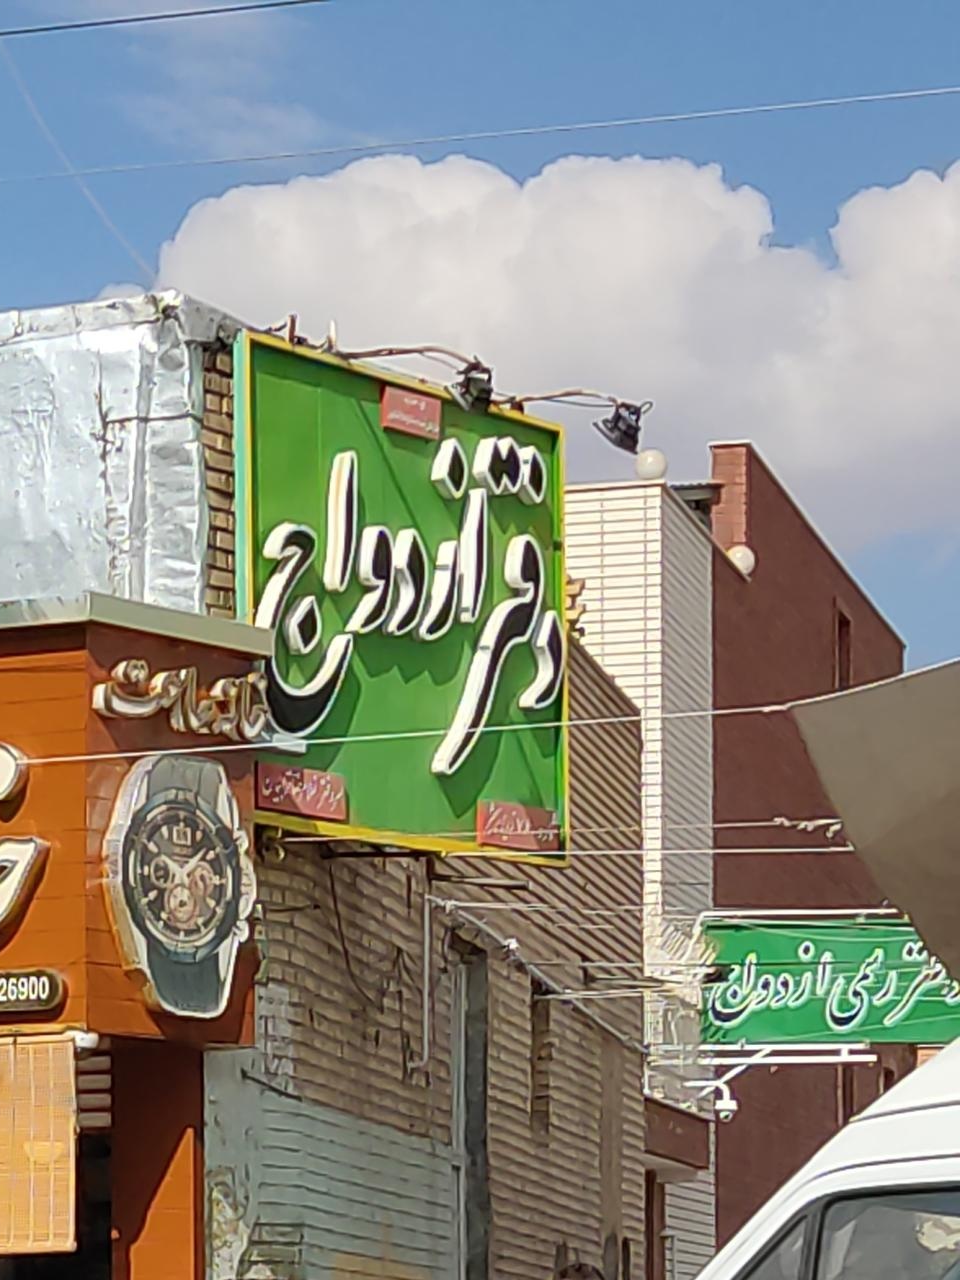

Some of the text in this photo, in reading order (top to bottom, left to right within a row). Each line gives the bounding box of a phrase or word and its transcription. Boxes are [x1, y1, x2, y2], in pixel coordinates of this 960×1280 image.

[254, 436, 565, 775] دفتر ازدواج
[91, 659, 222, 735] ساعت
[708, 940, 837, 1027] ازدواج
